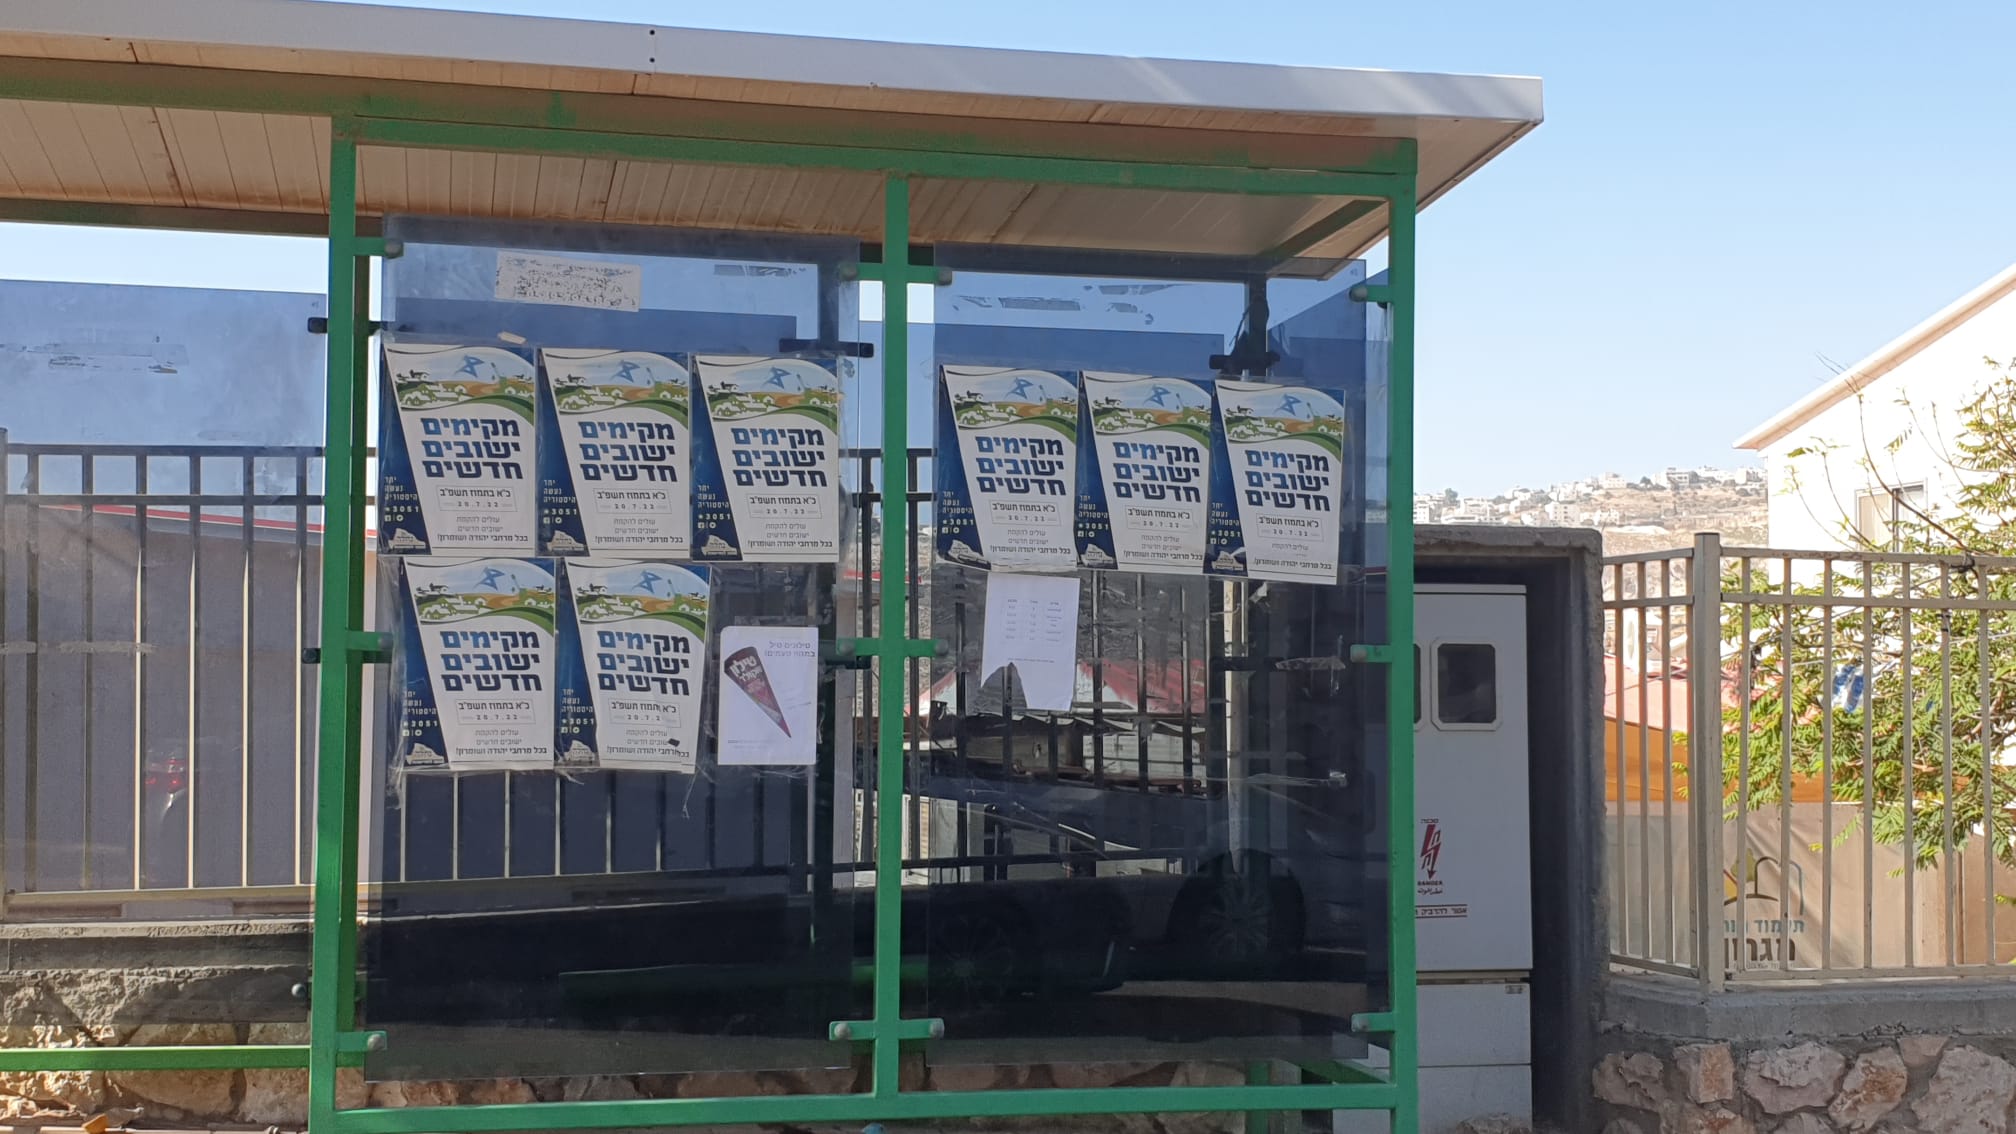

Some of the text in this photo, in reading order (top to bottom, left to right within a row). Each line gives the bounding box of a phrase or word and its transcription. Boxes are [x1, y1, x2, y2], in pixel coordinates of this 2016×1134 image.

[421, 418, 520, 439] מקימים
[578, 422, 675, 442] מקימים
[731, 428, 824, 448] מקימים
[975, 436, 1063, 457] מקימים
[422, 440, 520, 458] ישובים
[580, 444, 675, 461] ישובים
[732, 450, 825, 466] ישובים
[1113, 442, 1199, 464] מקימים
[423, 461, 523, 479] חדשים
[977, 458, 1063, 475] ישובים
[1245, 450, 1329, 473] מקימים
[581, 464, 677, 481] חדשים
[734, 470, 827, 486] חדשים
[1114, 463, 1199, 482] ישובים
[1246, 471, 1329, 491] ישובים
[469, 489, 495, 497] בתמוז
[626, 491, 650, 499] בתמוז
[977, 477, 1065, 495] חדשים
[1114, 482, 1200, 502] חדשים
[777, 496, 801, 504] בתמוז
[1018, 503, 1041, 512] בתמוז
[1246, 490, 1330, 511] חדשים
[1154, 510, 1176, 518] בתמוז
[1283, 518, 1305, 527] בתמוז
[440, 632, 540, 651] מקימים
[597, 631, 689, 654] מקימים
[441, 654, 540, 670] ישובים
[597, 653, 689, 674] ישובים
[442, 674, 542, 691] חדשים
[597, 673, 689, 695] חדשים
[488, 701, 514, 709] בתמוז
